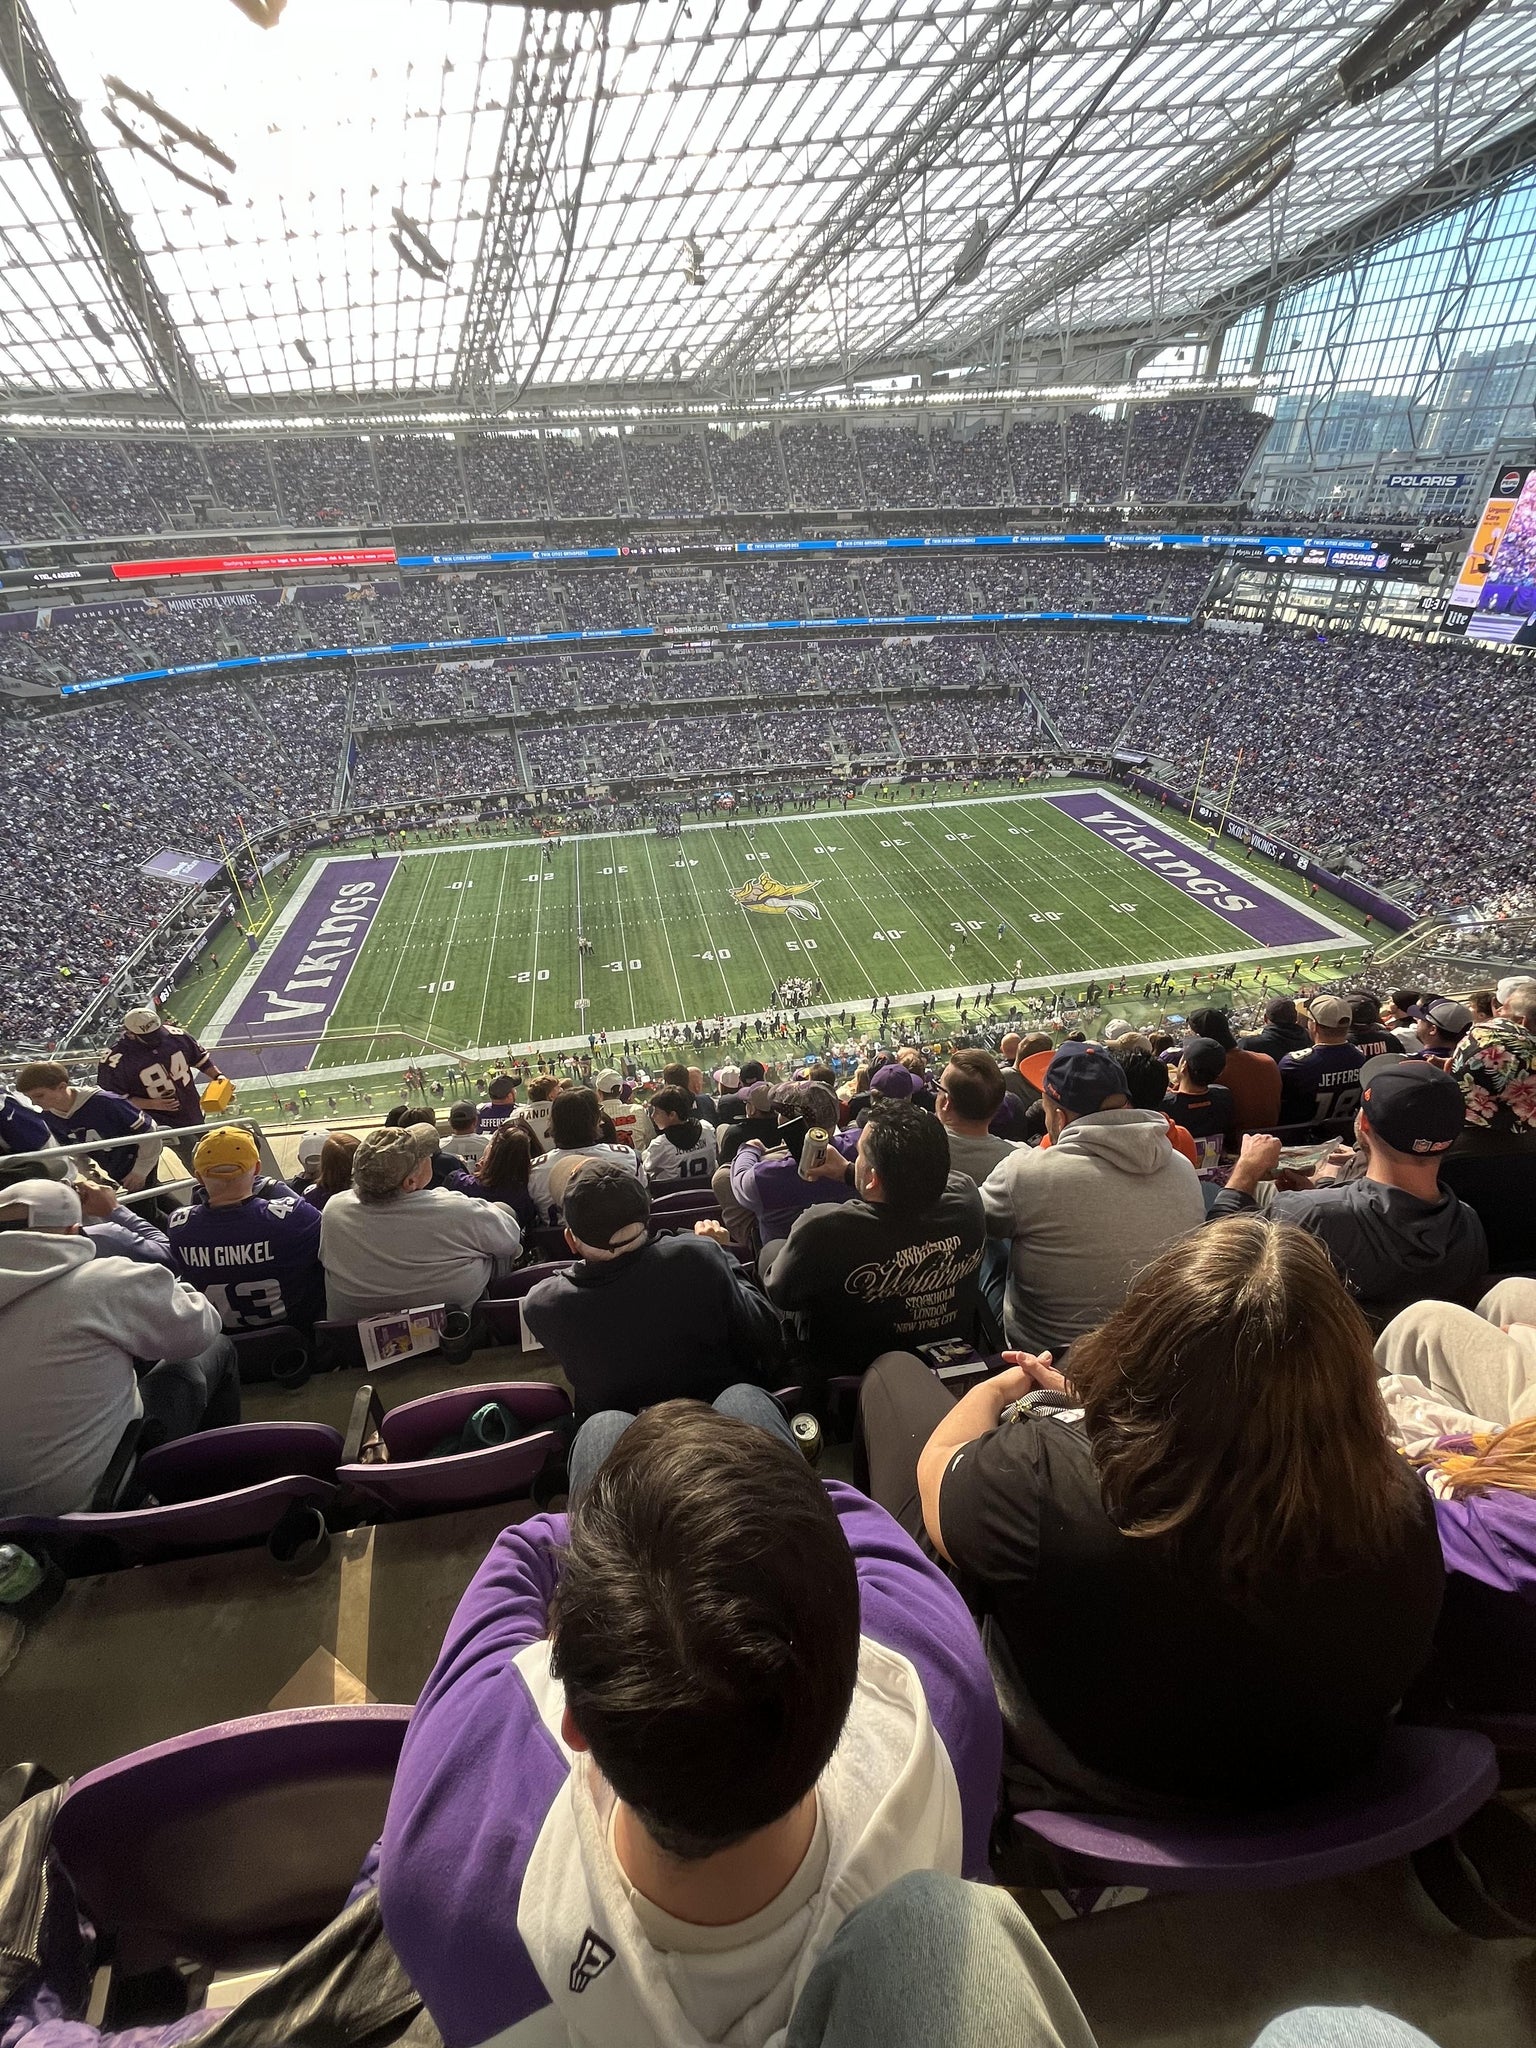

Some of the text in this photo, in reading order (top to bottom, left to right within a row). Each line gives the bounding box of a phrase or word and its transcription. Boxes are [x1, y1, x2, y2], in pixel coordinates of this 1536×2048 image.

[1390, 476, 1458, 487] POLARIS
[1332, 553, 1375, 562] AROUND
[168, 594, 257, 611] MINNESOTA VIKINGS
[1421, 598, 1446, 610] 10:31
[75, 611, 103, 619] HOME
[1446, 611, 1469, 627] Lite
[1226, 822, 1278, 857] SKOL VIKINGS
[745, 852, 770, 861] 50
[1081, 810, 1258, 913] VIKINGS
[1167, 831, 1201, 848] TAKES
[1223, 863, 1238, 873] OF
[1240, 874, 1258, 882] US
[603, 866, 628, 875] 30
[529, 873, 555, 883] 20
[1109, 903, 1135, 914] 10
[1029, 911, 1059, 924] 20
[950, 920, 980, 932] 30
[872, 929, 900, 941] 40
[242, 925, 288, 977] END RACISM
[786, 939, 818, 951] 50
[247, 881, 380, 1025] VIKINGS
[701, 949, 733, 961] 40
[611, 959, 642, 972] 30
[517, 969, 551, 983] 20
[427, 980, 456, 994] 10
[140, 1051, 191, 1099] 84
[1319, 1070, 1361, 1087] JEFFERS
[480, 1118, 507, 1127] JEFFERS
[179, 1241, 275, 1267] VAN GINKEL
[905, 1286, 955, 1309] STOCKHOLM
[913, 1303, 947, 1320] LONDON
[896, 1310, 958, 1333] NEW YORK CITY
